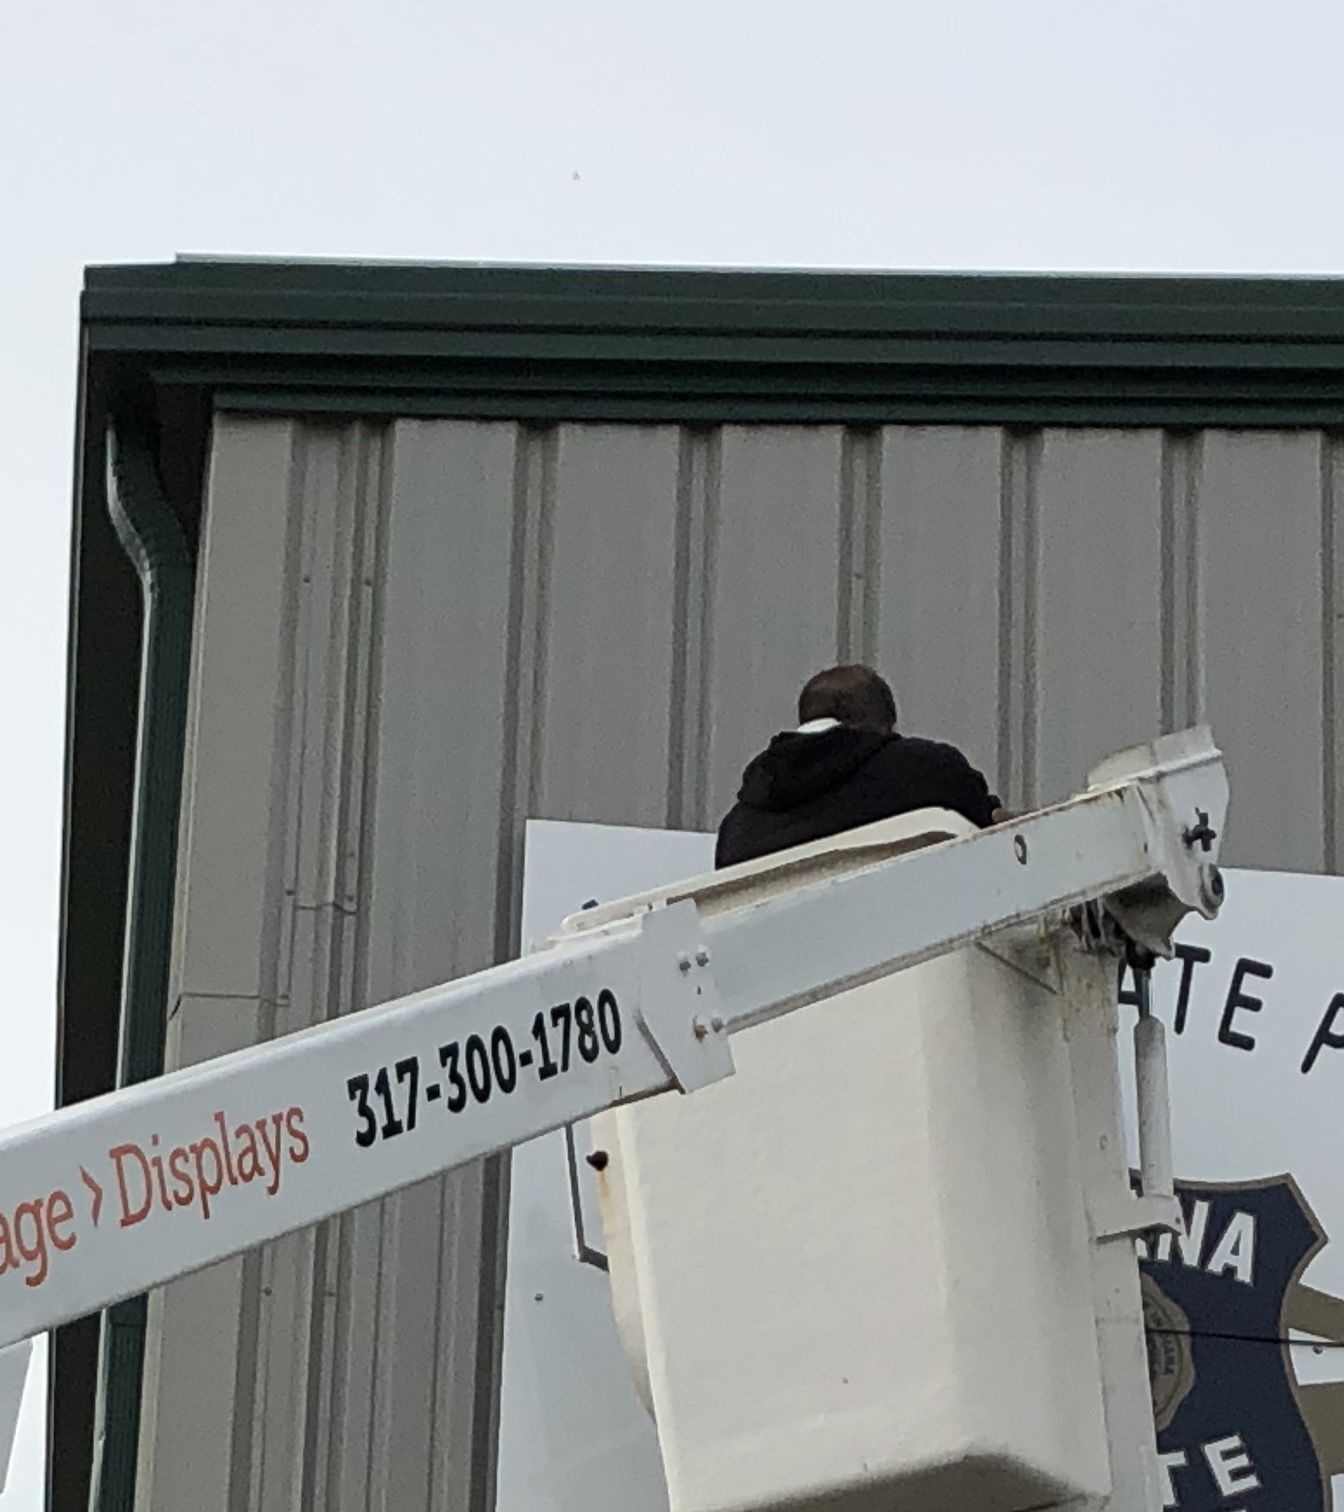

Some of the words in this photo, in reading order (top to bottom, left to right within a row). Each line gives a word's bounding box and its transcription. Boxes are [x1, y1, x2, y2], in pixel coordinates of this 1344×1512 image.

[346, 987, 623, 1148] 317-300-1780
[110, 1101, 309, 1229] Displays
[1135, 1199, 1255, 1284] NA
